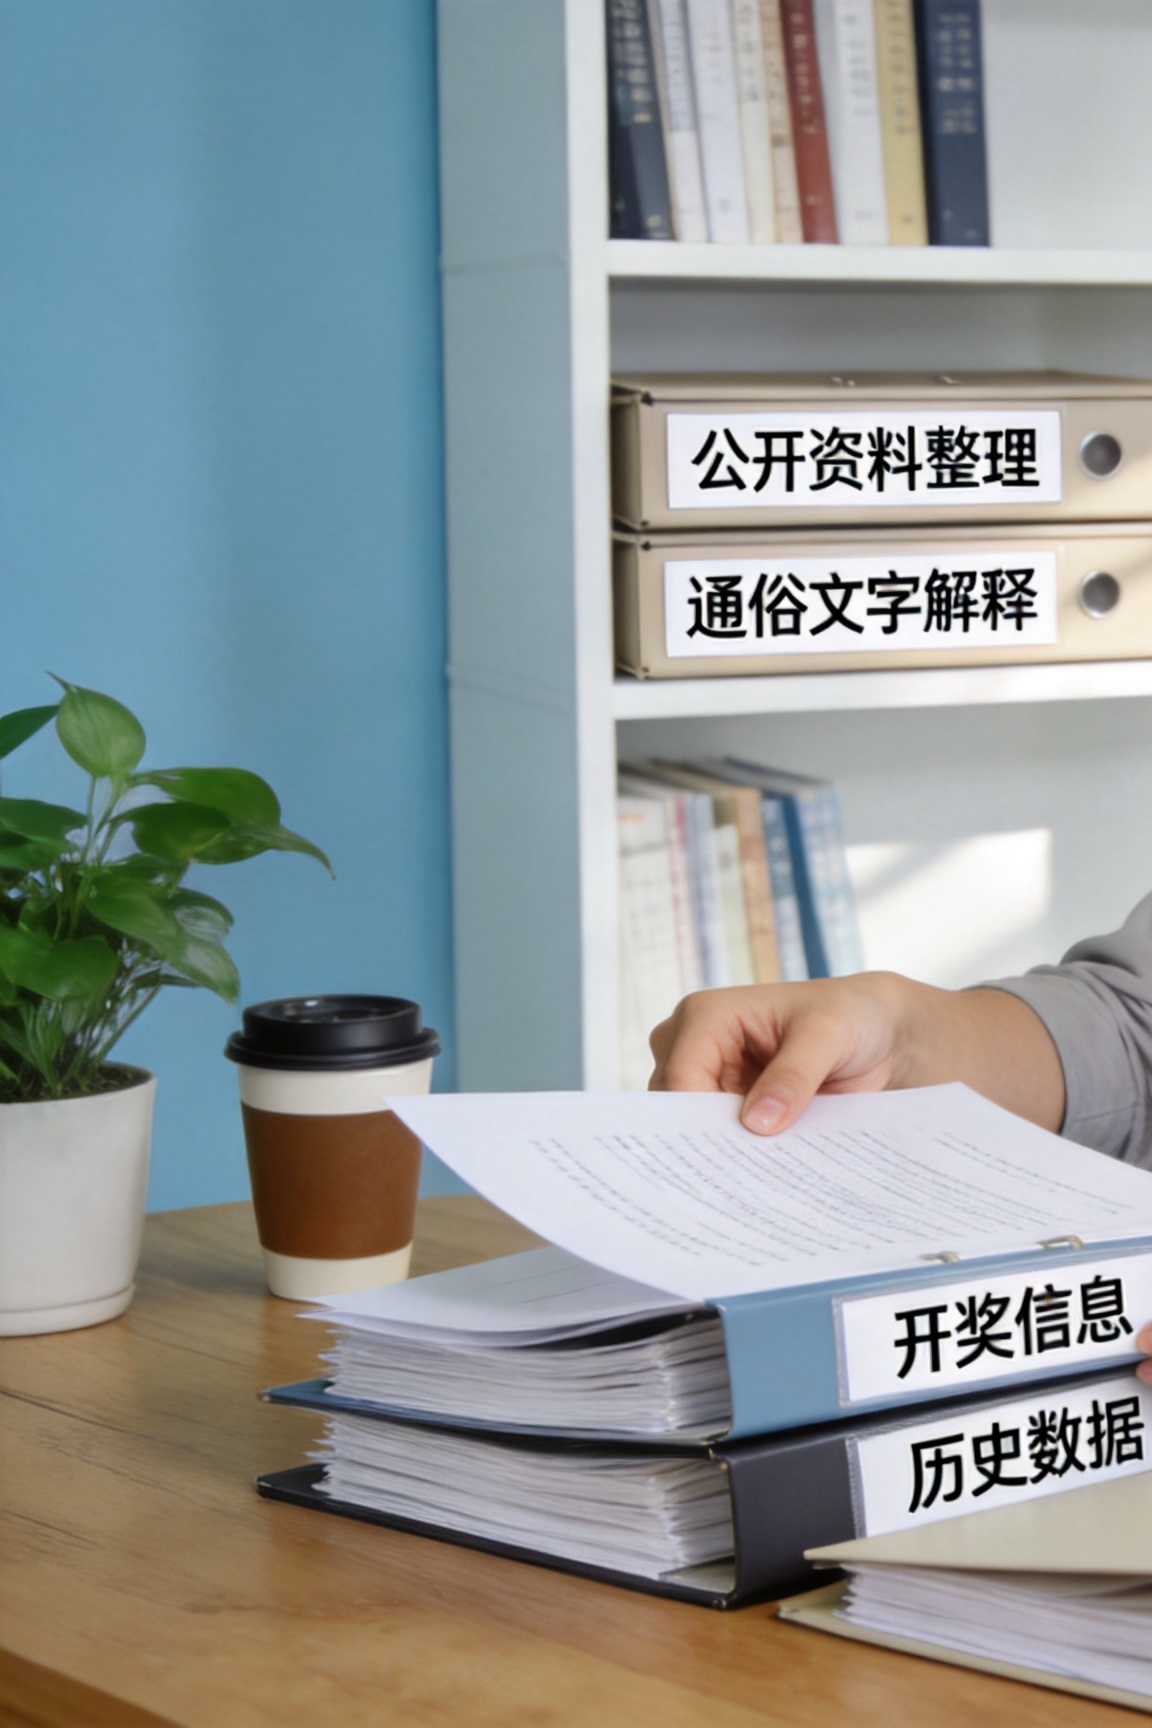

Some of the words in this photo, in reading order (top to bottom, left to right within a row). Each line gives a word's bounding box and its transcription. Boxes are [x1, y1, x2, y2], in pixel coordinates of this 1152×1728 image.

[691, 425, 1040, 493] 公开资料整理
[686, 567, 1038, 639] 通俗文字解释
[894, 1275, 1134, 1379] 开奖信息
[908, 1395, 1145, 1514] 历史数据
